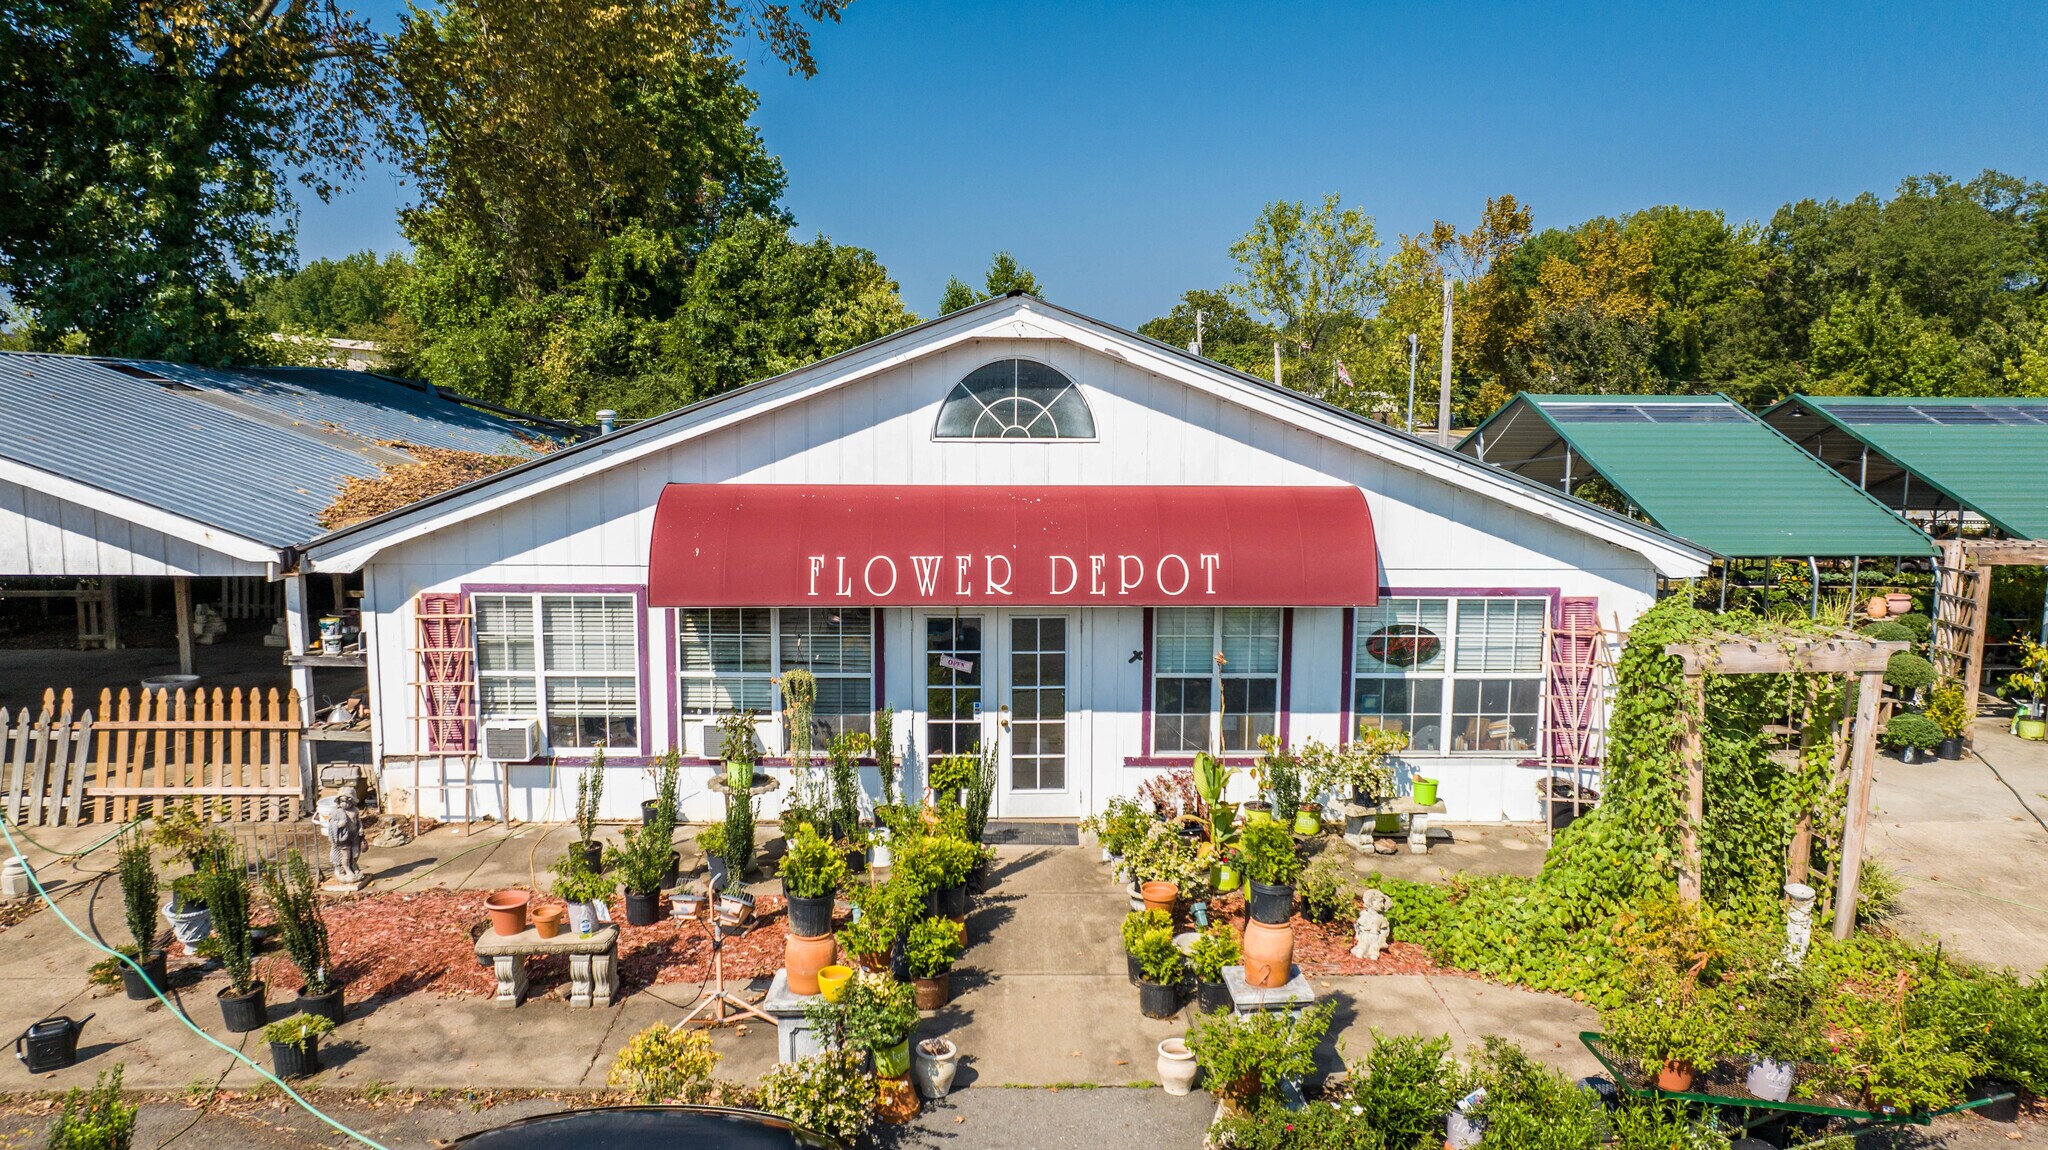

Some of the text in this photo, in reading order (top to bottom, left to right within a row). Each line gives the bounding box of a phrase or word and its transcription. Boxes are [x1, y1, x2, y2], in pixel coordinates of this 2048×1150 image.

[807, 553, 1219, 597] FLOWER DEPOT
[947, 659, 966, 668] OPEN
